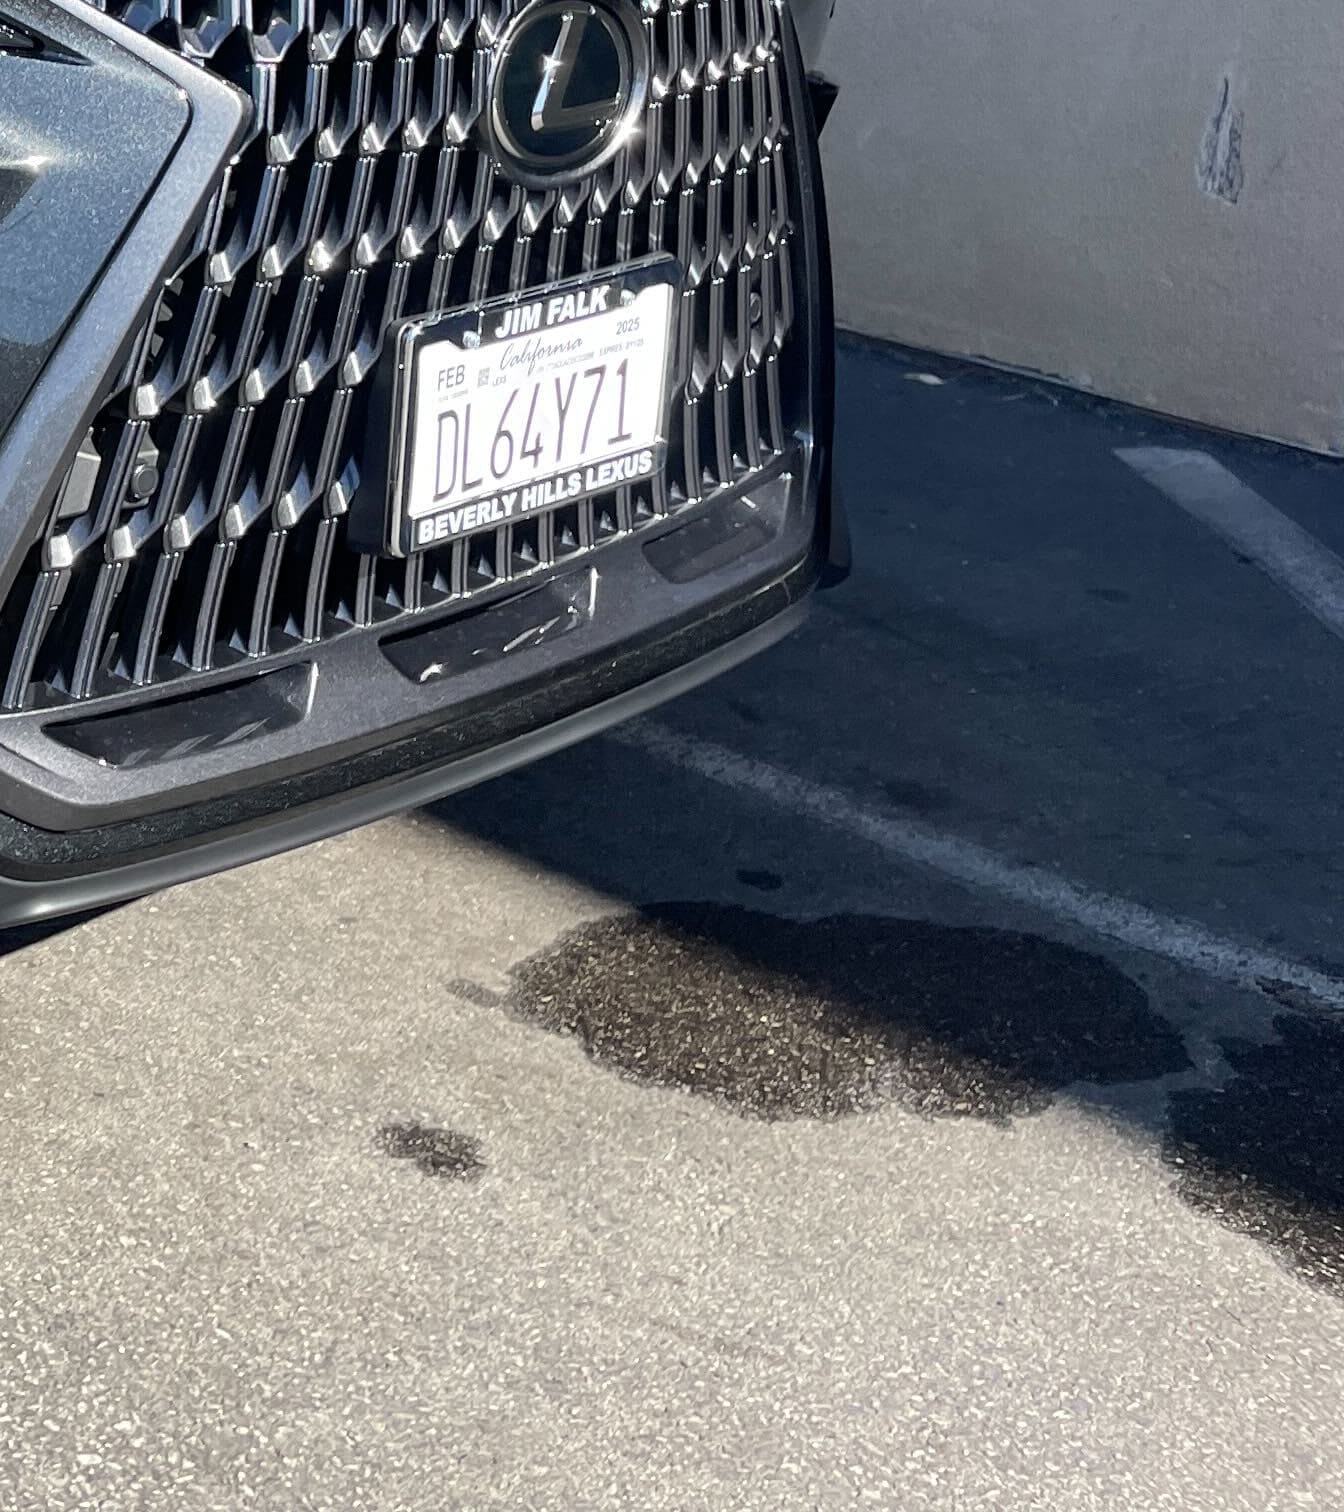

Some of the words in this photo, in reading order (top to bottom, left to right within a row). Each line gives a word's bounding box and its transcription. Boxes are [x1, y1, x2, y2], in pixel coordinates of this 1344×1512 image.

[495, 303, 543, 338] JIM
[547, 285, 611, 326] FALK
[616, 317, 641, 336] 2025
[437, 364, 466, 392] FEB
[499, 336, 584, 377] California
[432, 358, 633, 503] DL64Y71
[417, 493, 518, 545] BEVERLY
[521, 473, 583, 513] HILLS
[587, 451, 654, 486] LEXUS
